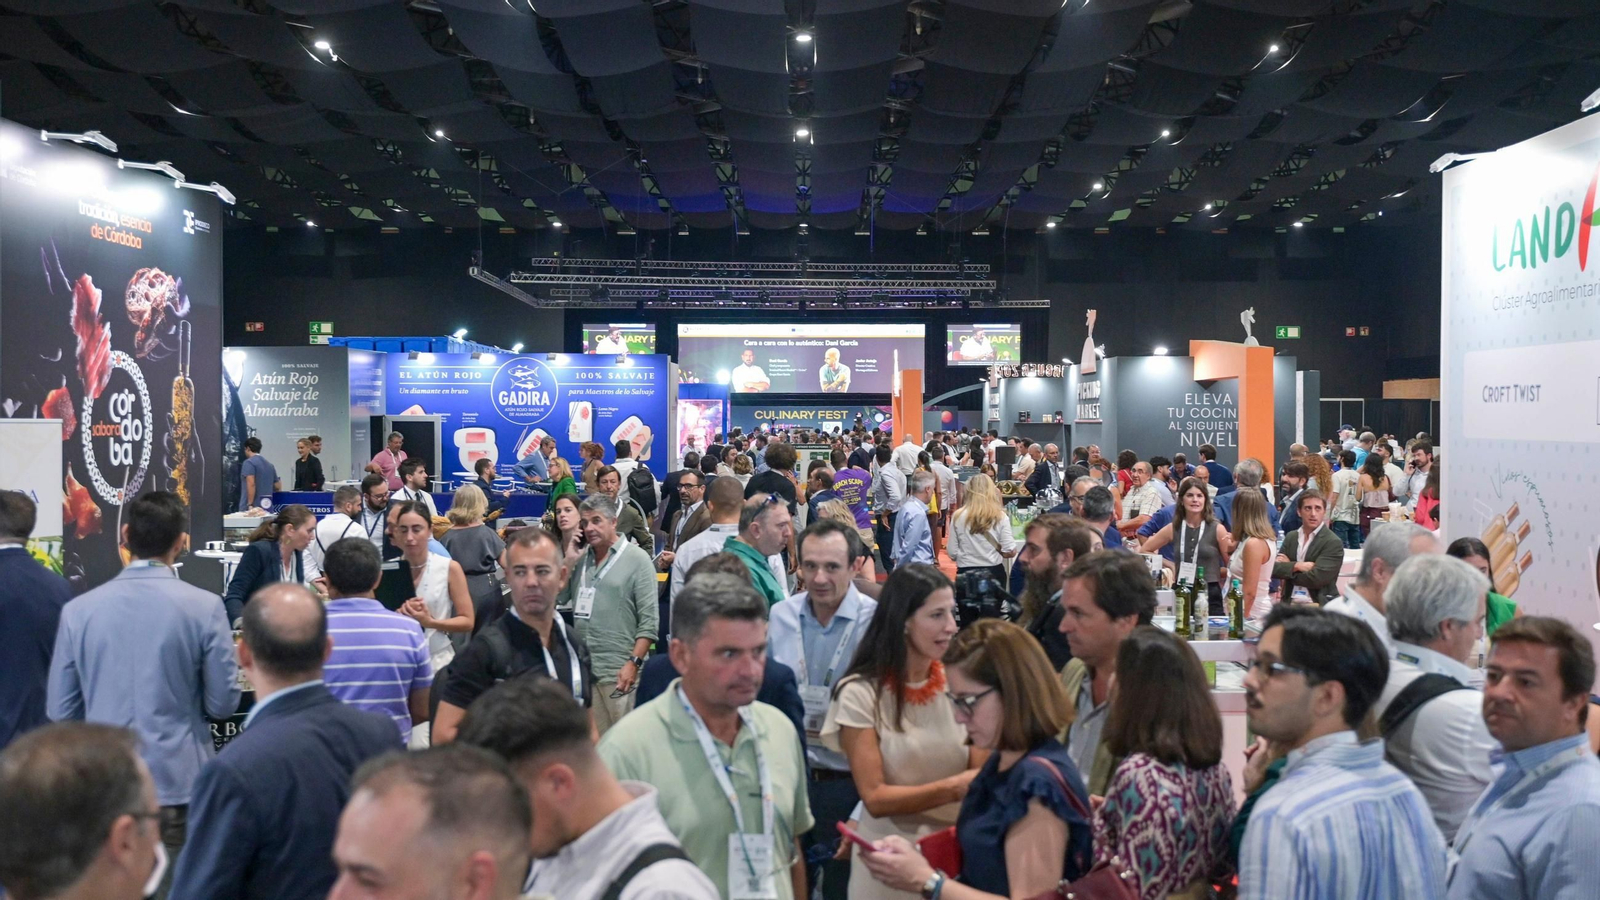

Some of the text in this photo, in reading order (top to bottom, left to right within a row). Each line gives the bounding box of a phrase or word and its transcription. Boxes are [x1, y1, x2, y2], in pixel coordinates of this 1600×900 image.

[120, 213, 152, 233] esencia
[91, 223, 142, 249] de Córdoba
[1492, 296, 1524, 311] Clúster
[250, 371, 319, 388] Atún Rojo
[399, 369, 482, 381] EL ATÚN ROJO
[608, 371, 655, 380] SALVAJE
[253, 387, 319, 405] Salvaje de
[399, 387, 409, 395] Un
[409, 386, 440, 395] diamante
[450, 386, 469, 395] bruto
[585, 388, 614, 396] Maestros
[632, 387, 655, 397] Salvaje
[1482, 384, 1541, 403] CROFT TWIST
[498, 390, 550, 406] GADIRA
[1185, 393, 1232, 405] ELEVA
[243, 403, 319, 417] Almadraba
[754, 410, 849, 420] CULINARY FEST
[1076, 403, 1101, 418] MARKET
[1167, 407, 1237, 419] TU COCIN
[1168, 421, 1240, 431] AL SIGUIENT
[1180, 432, 1237, 447] NIVEL
